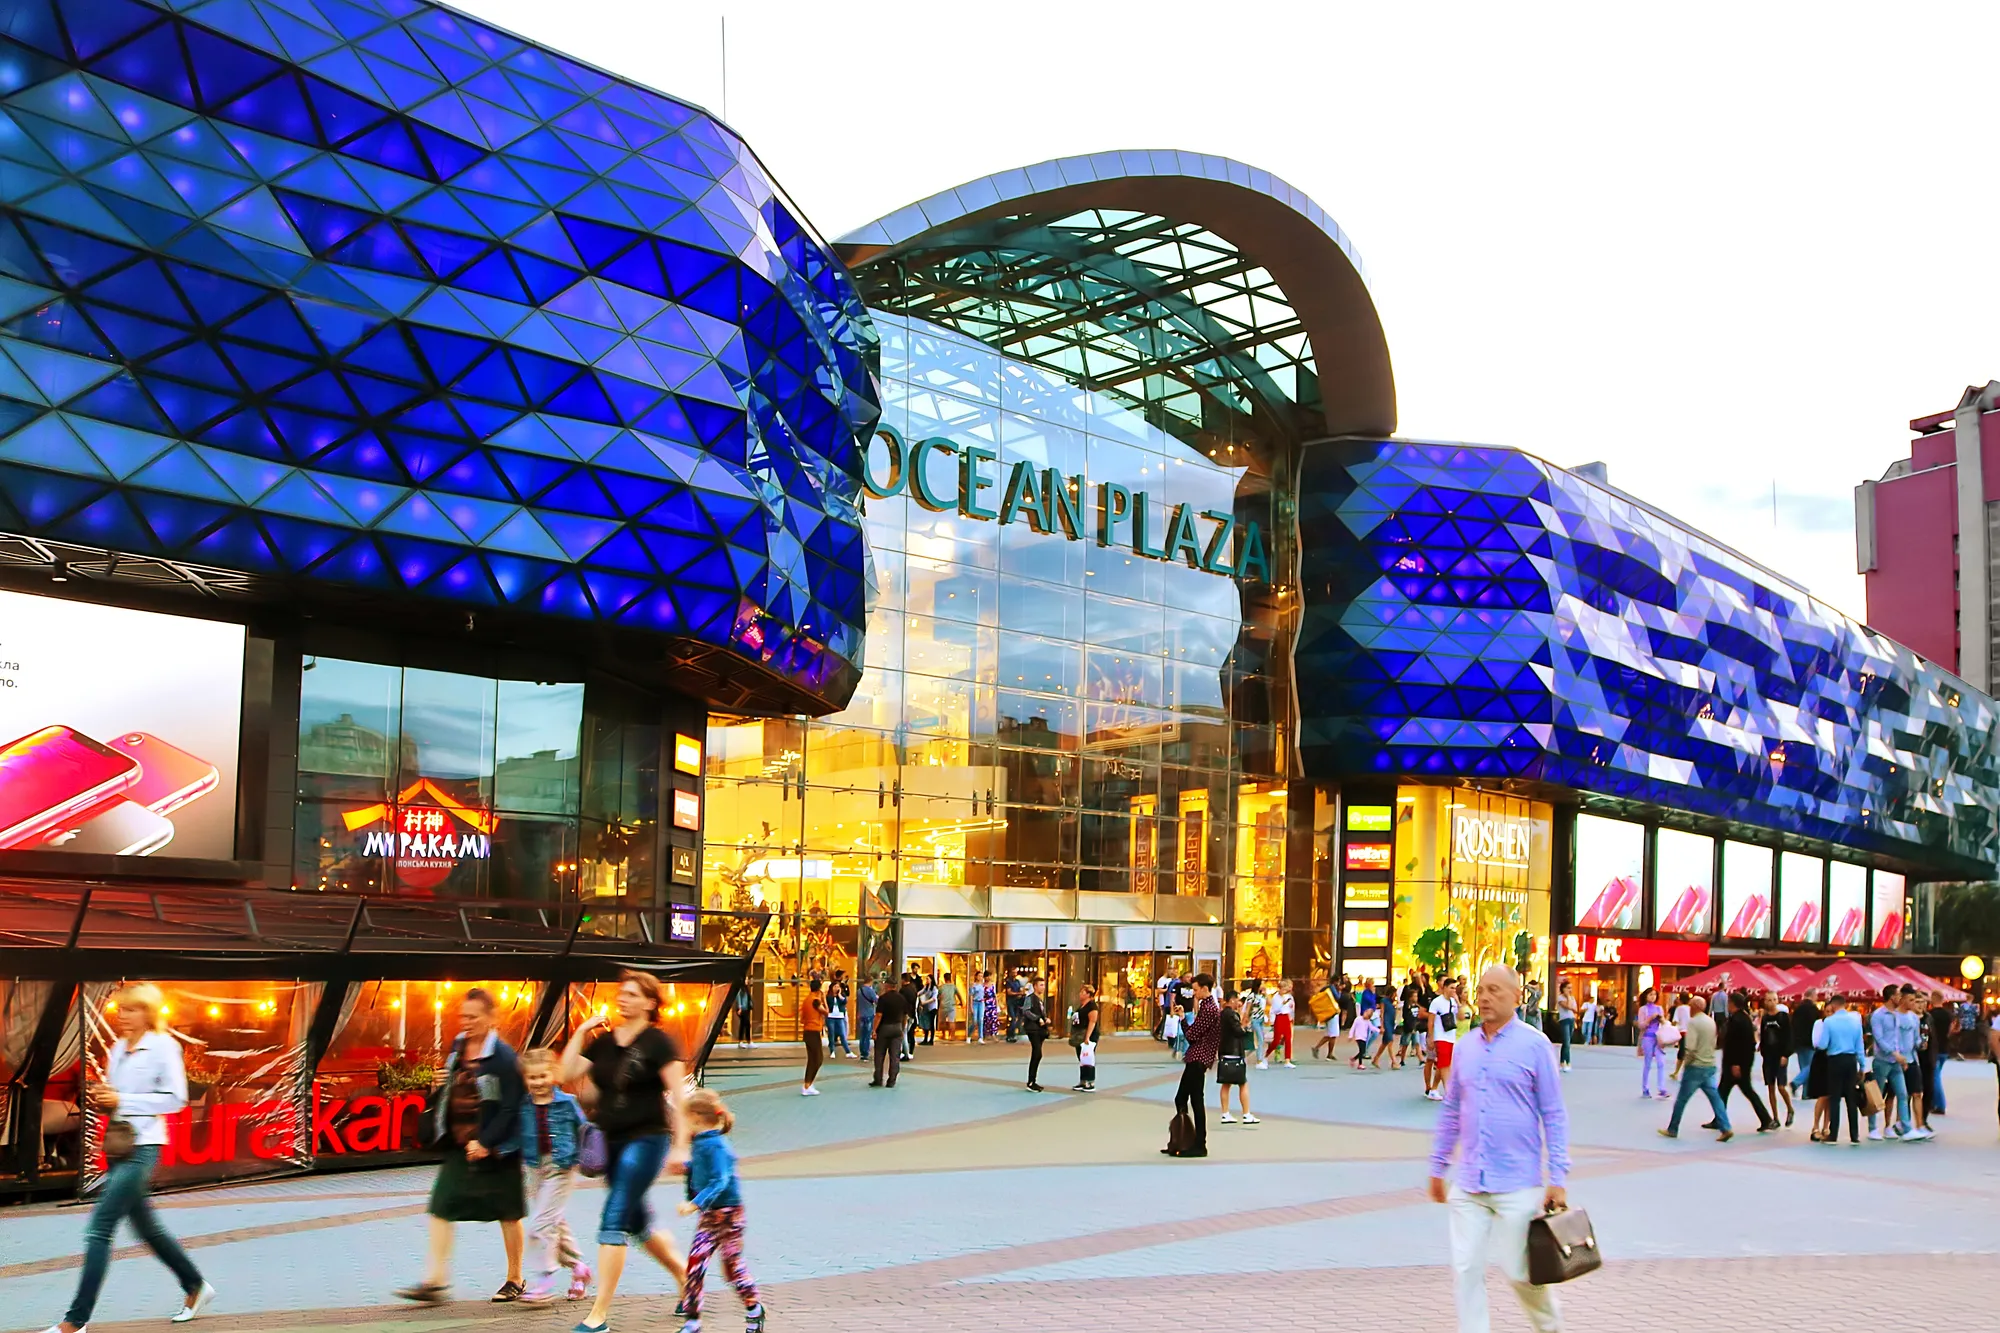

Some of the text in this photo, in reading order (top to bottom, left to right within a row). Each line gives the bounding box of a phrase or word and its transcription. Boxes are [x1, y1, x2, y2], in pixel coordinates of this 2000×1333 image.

[863, 422, 1270, 584] OCEAN PLAZA
[404, 809, 444, 832] 村神
[1455, 815, 1529, 863] ROSHEN
[430, 860, 452, 868] КУХНЯ
[1186, 829, 1198, 893] ROSHEN
[1595, 938, 1622, 962] KFC
[1672, 984, 1691, 993] KFC
[1695, 985, 1713, 993] KFC
